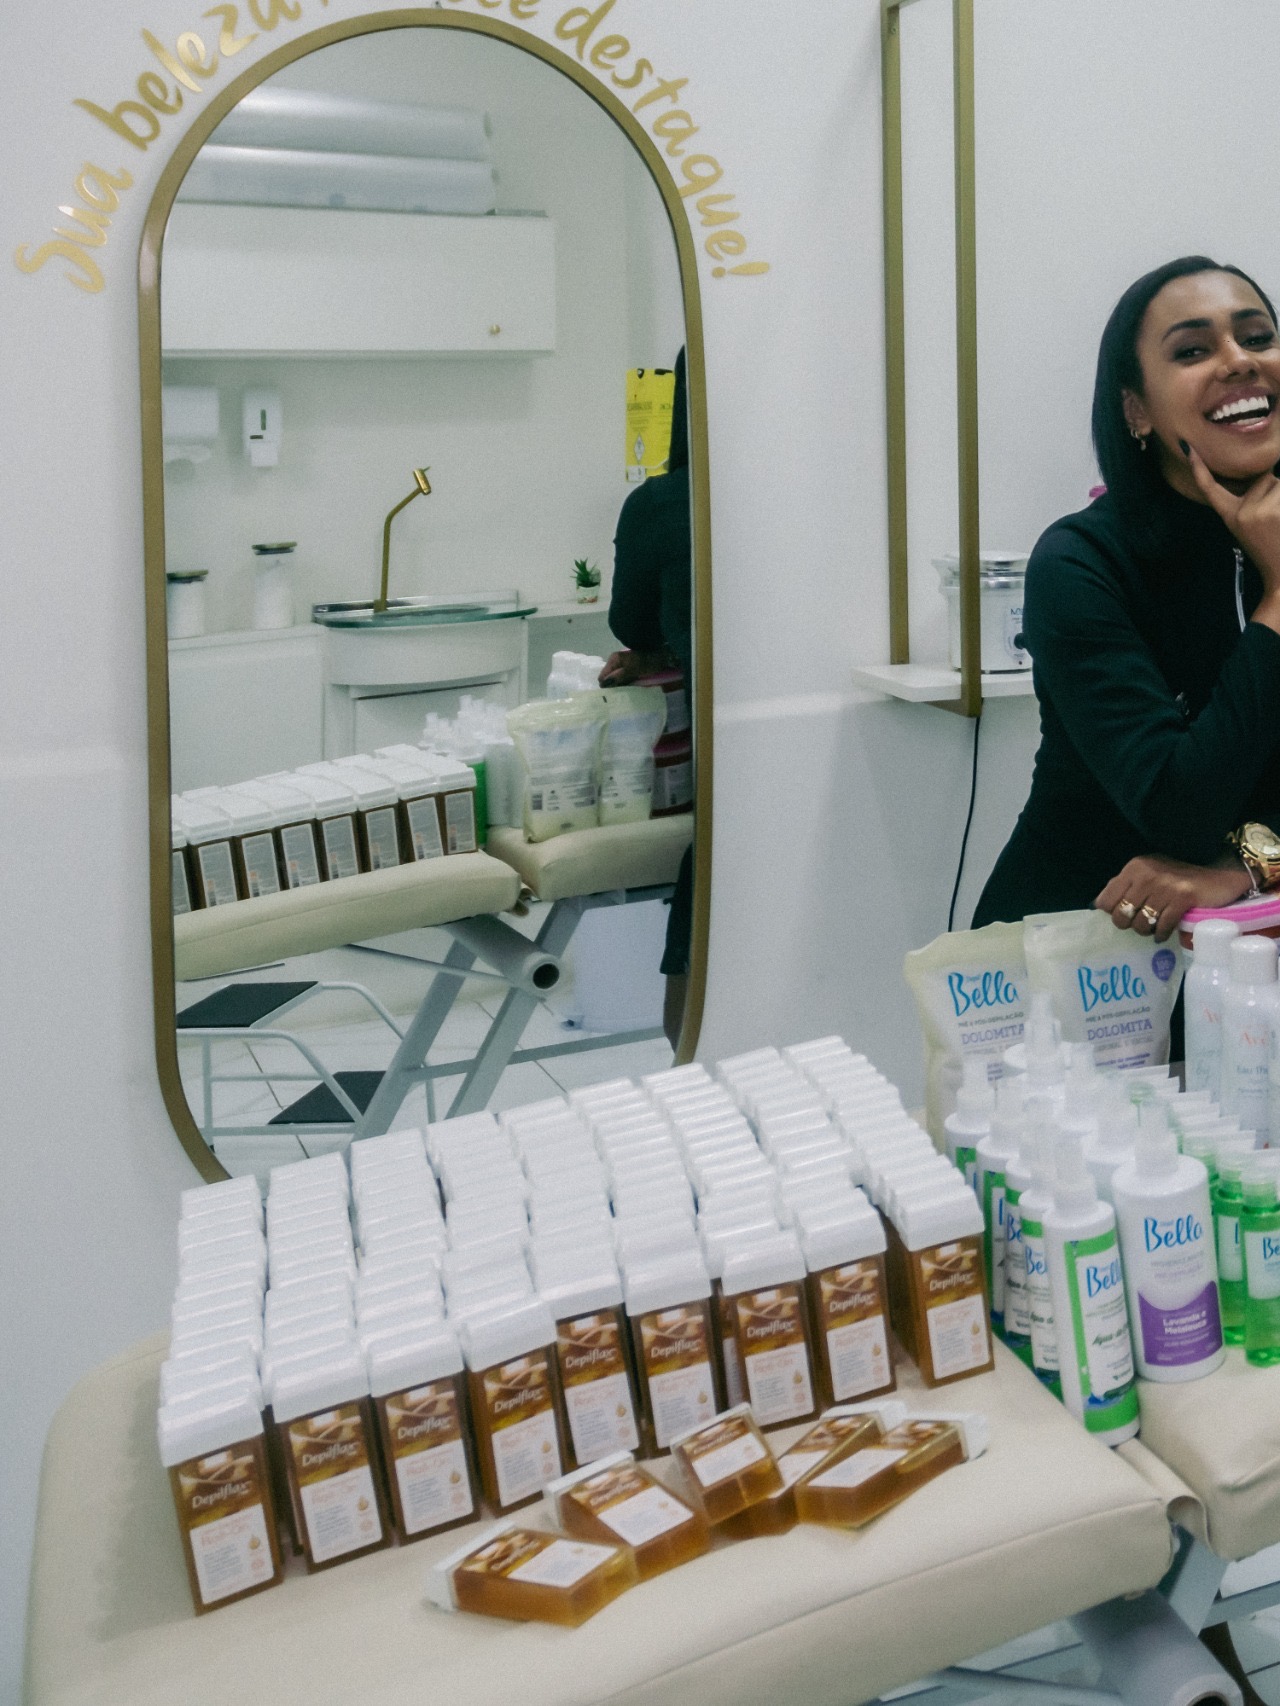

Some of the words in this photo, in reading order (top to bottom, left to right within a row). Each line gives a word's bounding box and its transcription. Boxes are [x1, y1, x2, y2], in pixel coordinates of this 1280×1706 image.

[13, 160, 134, 294] Sua
[554, 0, 769, 280] destaque!
[948, 970, 1020, 1017] Bella
[1078, 964, 1148, 1012] Bella
[1087, 1018, 1153, 1041] DOLOMITA
[1144, 1214, 1202, 1253] Bella
[929, 1272, 974, 1291] Depilflax
[1086, 1258, 1122, 1298] Bell
[829, 1292, 877, 1313] Depilflax
[747, 1319, 797, 1338] Depilflax
[565, 1348, 617, 1368] Depilflax
[651, 1339, 700, 1358] Depilflax
[494, 1386, 543, 1413] Depilflax
[397, 1416, 452, 1439] Depilflax
[302, 1441, 359, 1467] Depilflax
[192, 1480, 252, 1509] Depilflax
